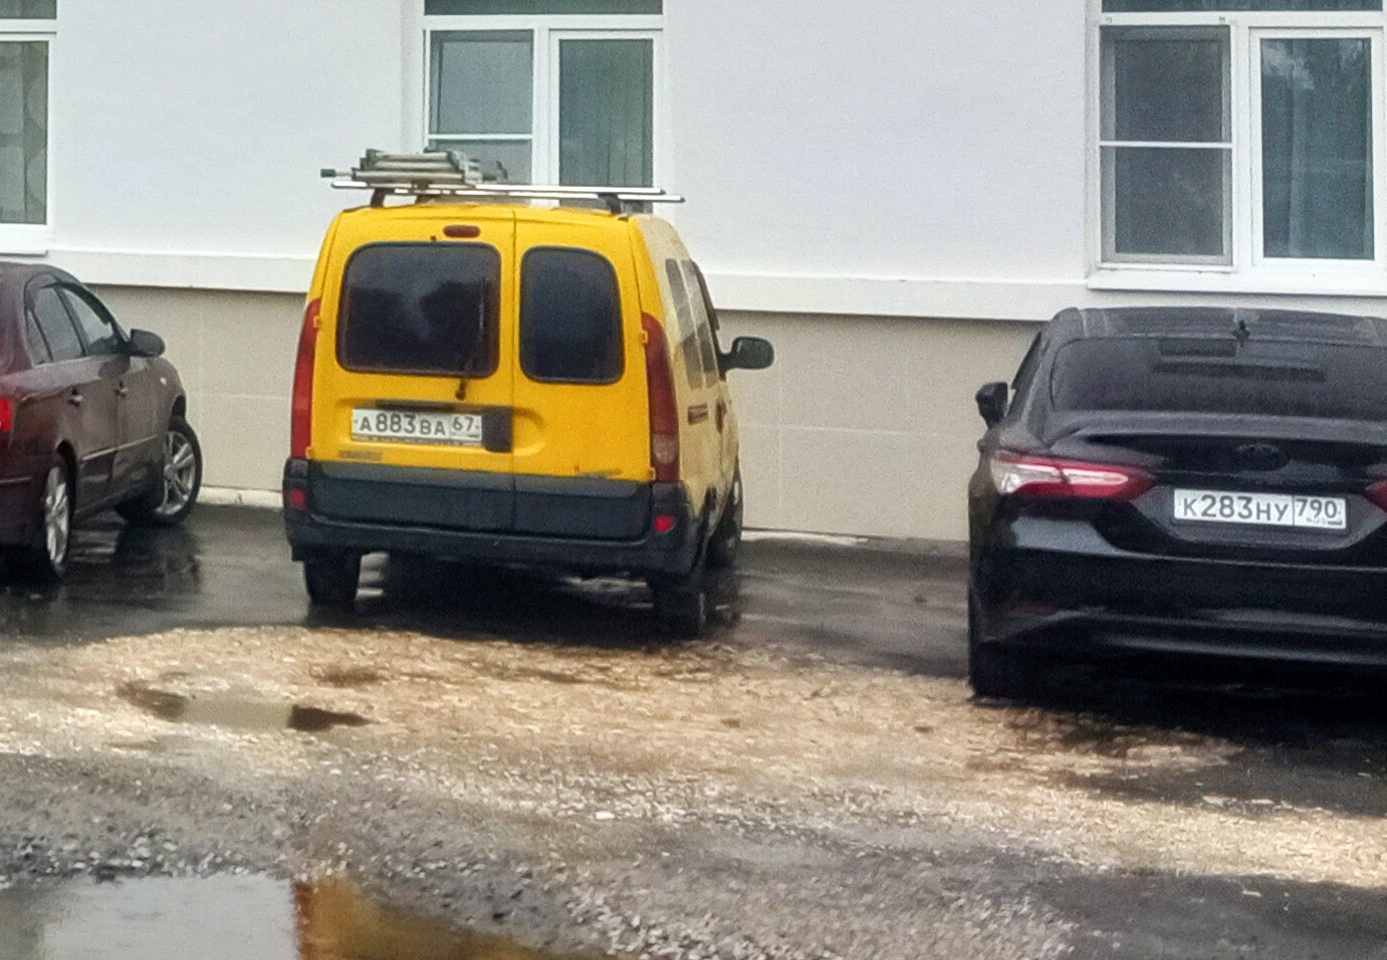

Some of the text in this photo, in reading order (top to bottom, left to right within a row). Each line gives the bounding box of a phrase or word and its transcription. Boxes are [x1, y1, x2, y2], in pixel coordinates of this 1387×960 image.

[359, 413, 474, 436] А883ВА 67
[1183, 494, 1338, 522] К283НУ 790
